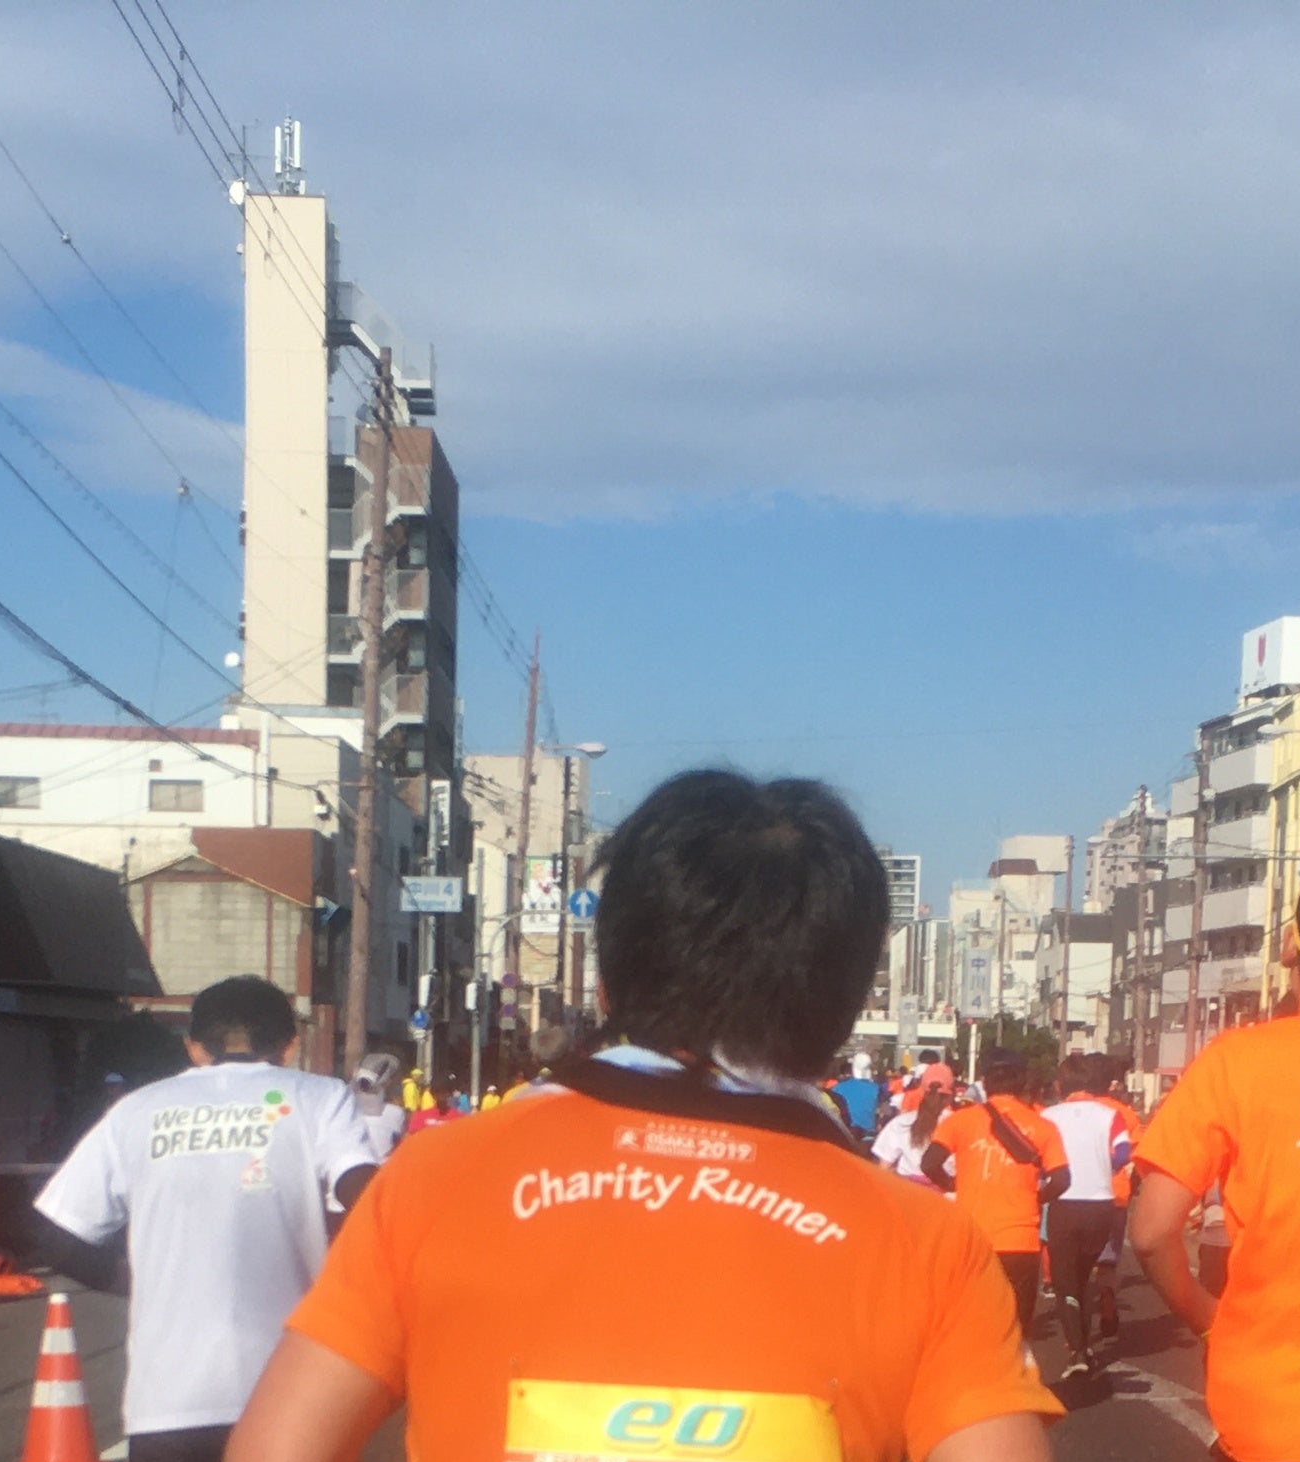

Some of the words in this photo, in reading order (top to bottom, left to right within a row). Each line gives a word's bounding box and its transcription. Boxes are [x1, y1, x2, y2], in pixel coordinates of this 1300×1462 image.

[153, 1107, 190, 1131] We
[192, 1104, 264, 1125] Drive
[151, 1125, 269, 1159] DREAMS
[696, 1139, 753, 1161] 2019
[512, 1162, 684, 1220] Charity
[687, 1166, 847, 1244] Runner
[605, 1398, 746, 1448] eo
